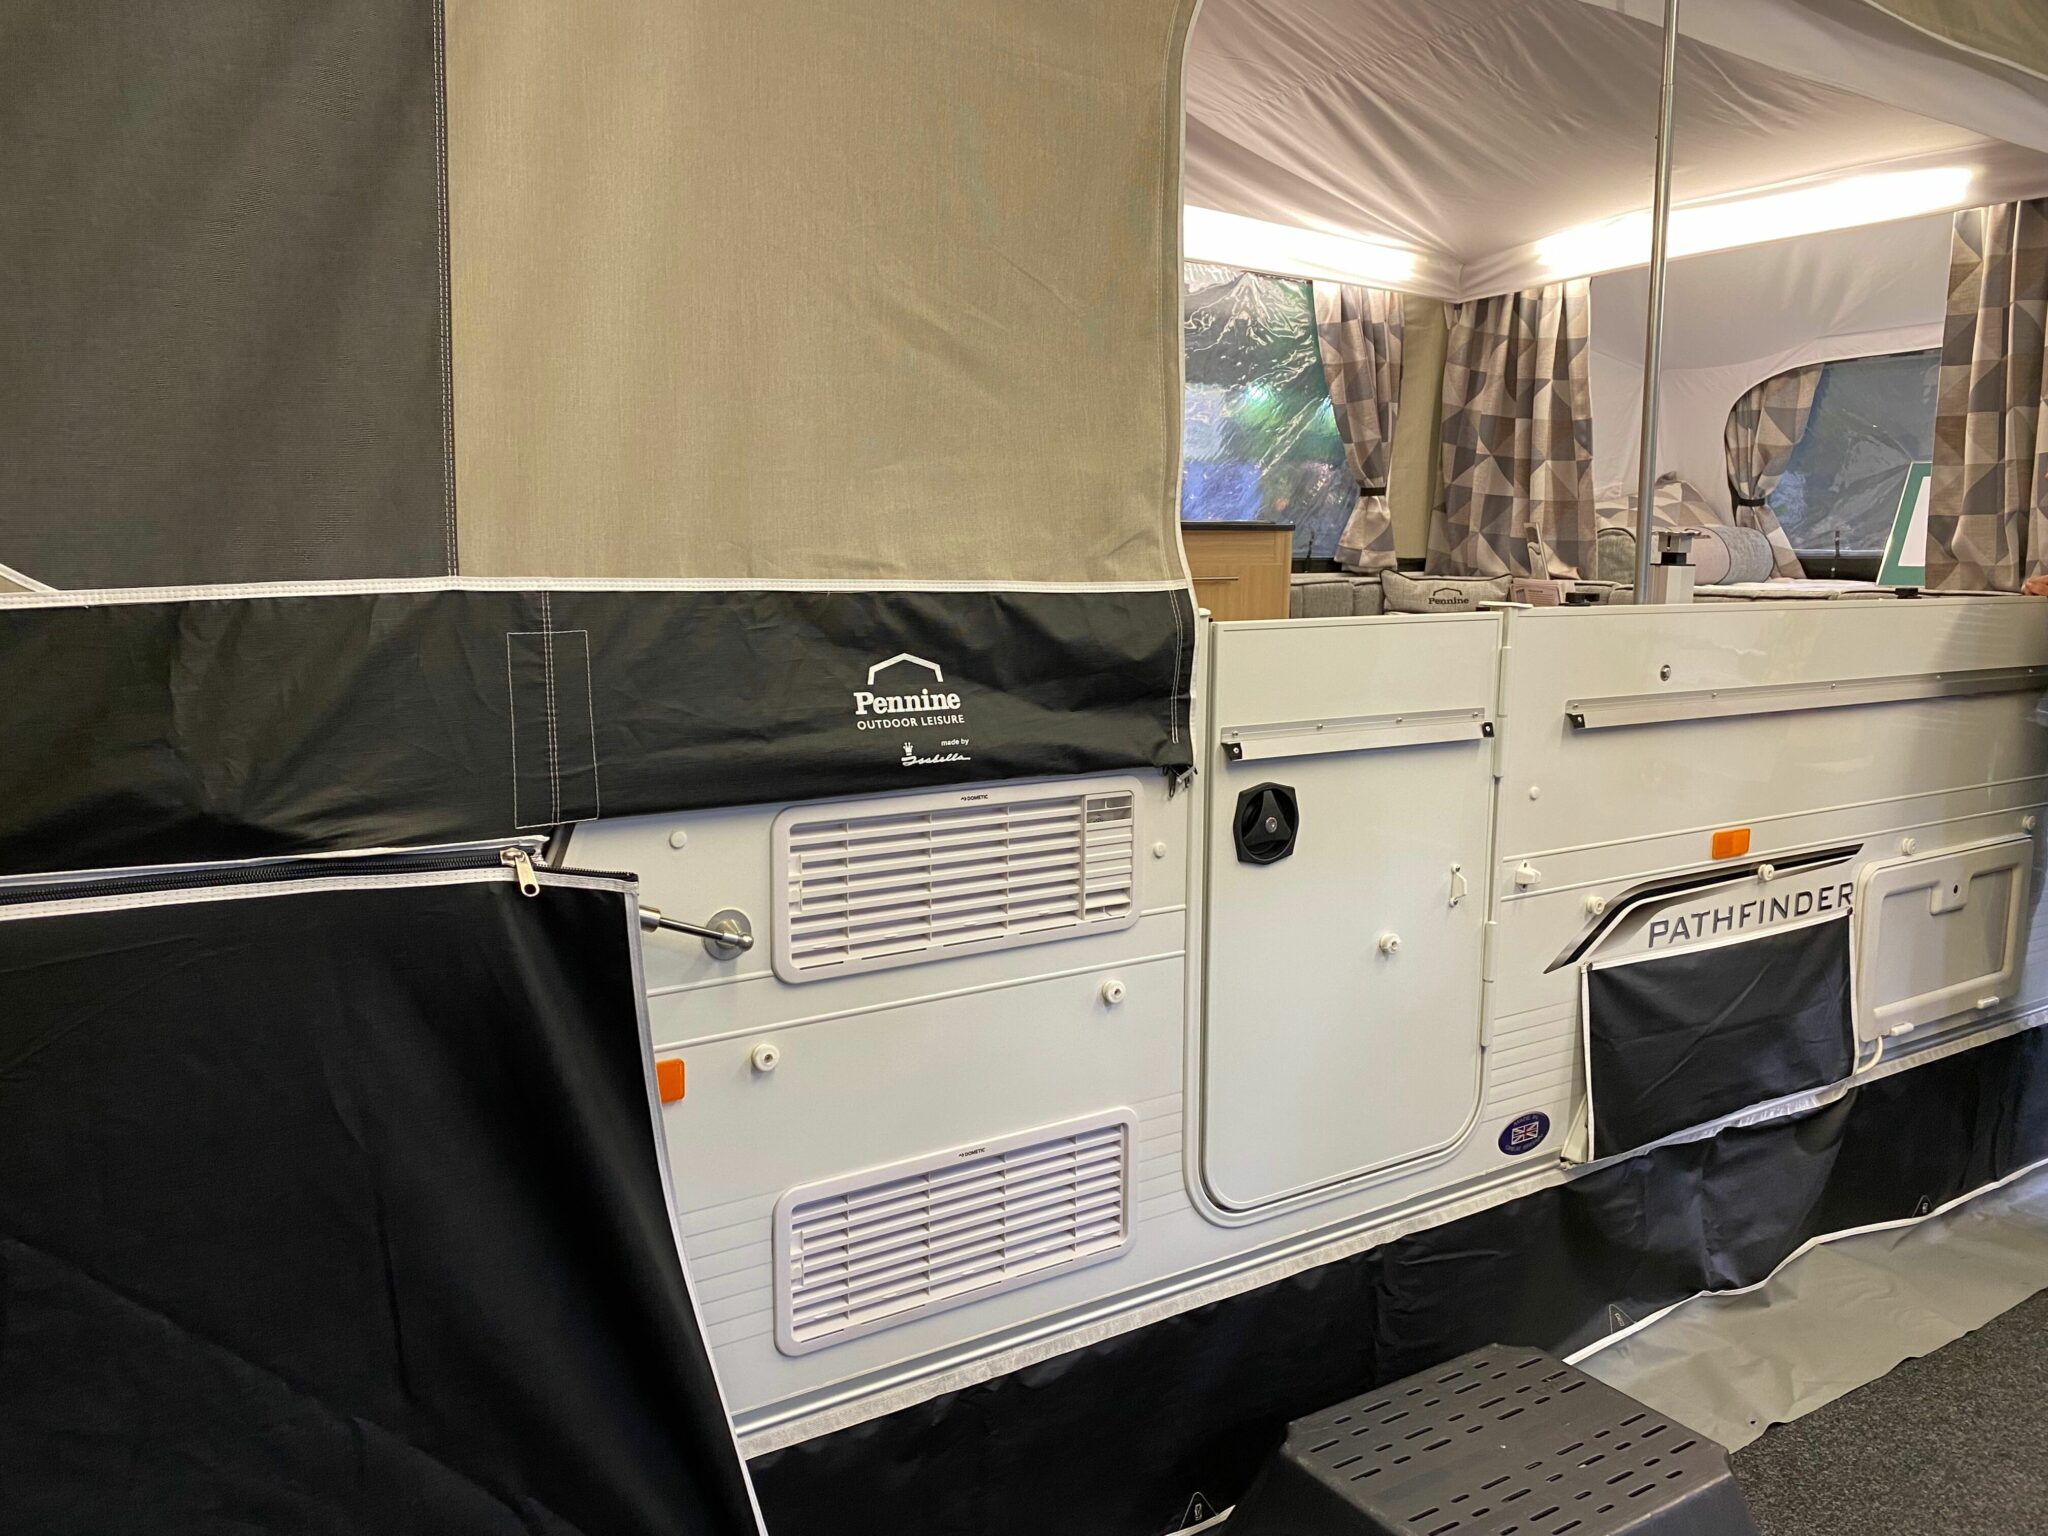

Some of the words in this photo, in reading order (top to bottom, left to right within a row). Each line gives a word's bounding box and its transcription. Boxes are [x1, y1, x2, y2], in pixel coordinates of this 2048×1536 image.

[1428, 596, 1469, 605] Pennine
[853, 688, 961, 715] Pennine
[857, 717, 918, 731] OUTDOOR
[920, 714, 965, 726] LEISURE
[941, 738, 959, 746] made
[961, 737, 970, 746] by
[901, 752, 971, 767] Isabella
[1648, 882, 1854, 948] PATHFINDER
[965, 1147, 986, 1157] DOMETIC
